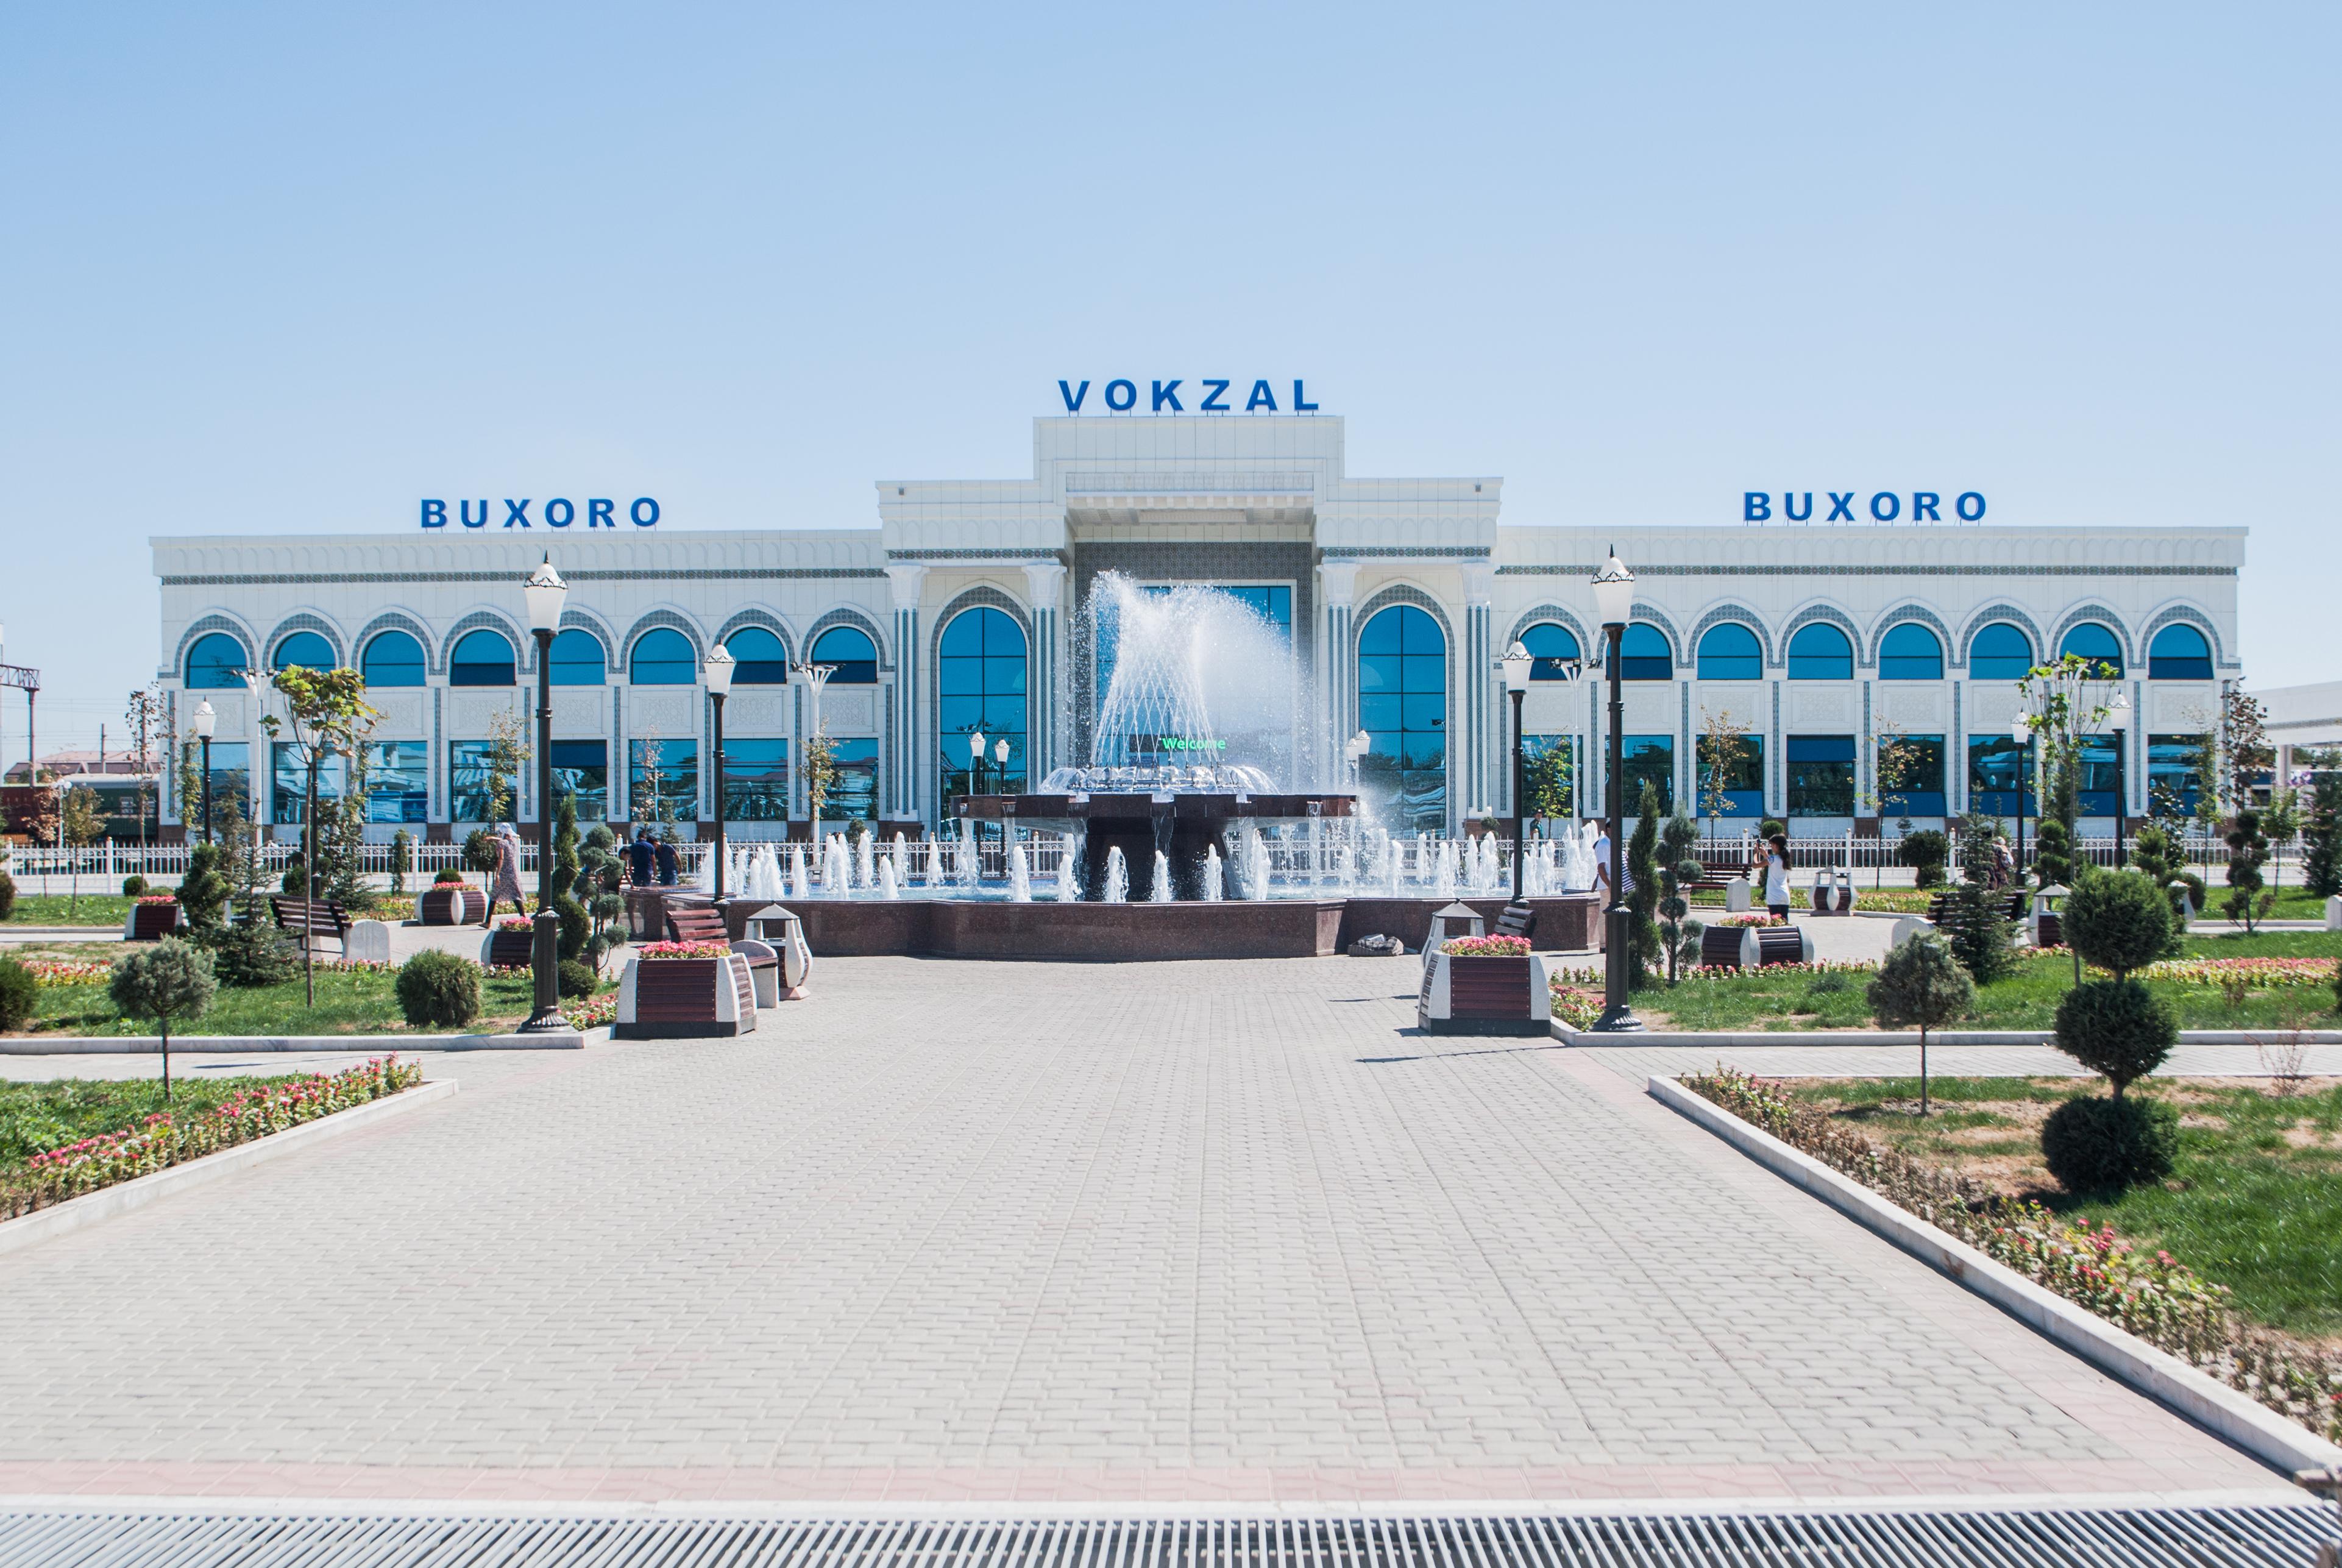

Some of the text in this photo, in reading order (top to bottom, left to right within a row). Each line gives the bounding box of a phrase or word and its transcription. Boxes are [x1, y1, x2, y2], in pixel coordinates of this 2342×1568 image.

[1057, 379, 1319, 411] VOKZAL
[420, 497, 660, 528] BUXORO
[1744, 491, 1987, 522] BUXORO
[1162, 737, 1226, 750] Welcome
